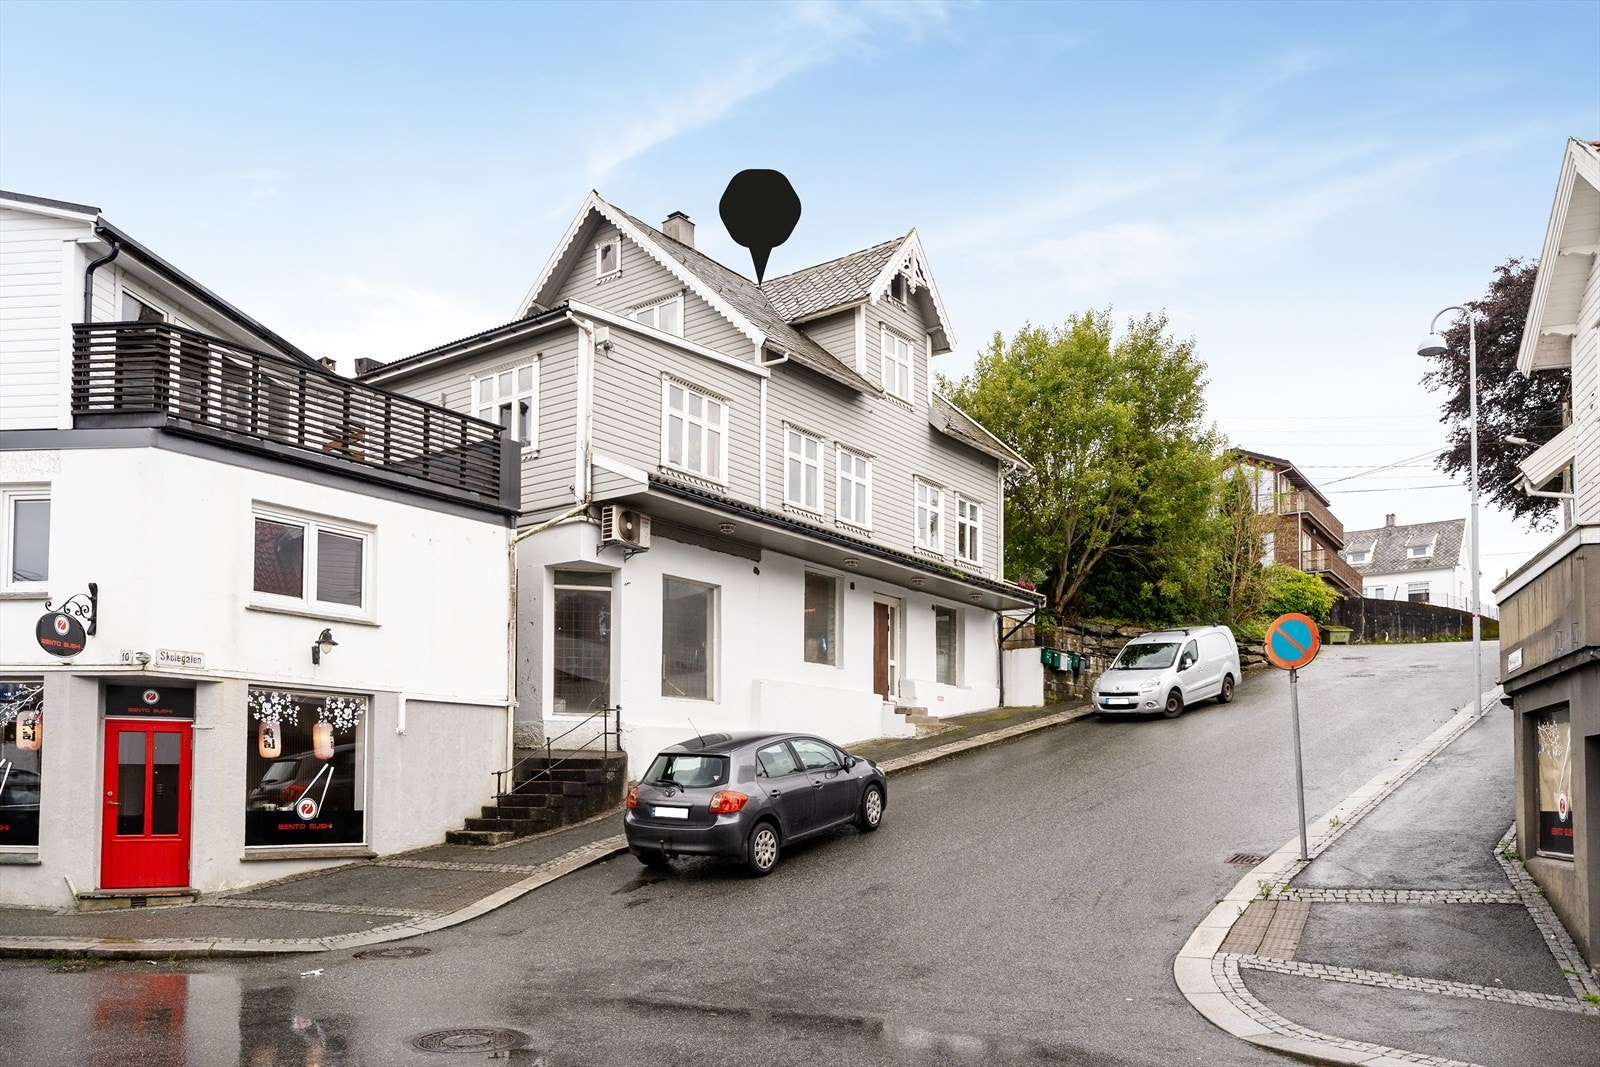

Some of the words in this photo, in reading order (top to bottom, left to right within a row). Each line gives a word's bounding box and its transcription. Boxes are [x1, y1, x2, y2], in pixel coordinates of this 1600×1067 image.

[41, 638, 61, 647] BENTO
[63, 641, 82, 649] SUSHI
[121, 652, 130, 661] 10
